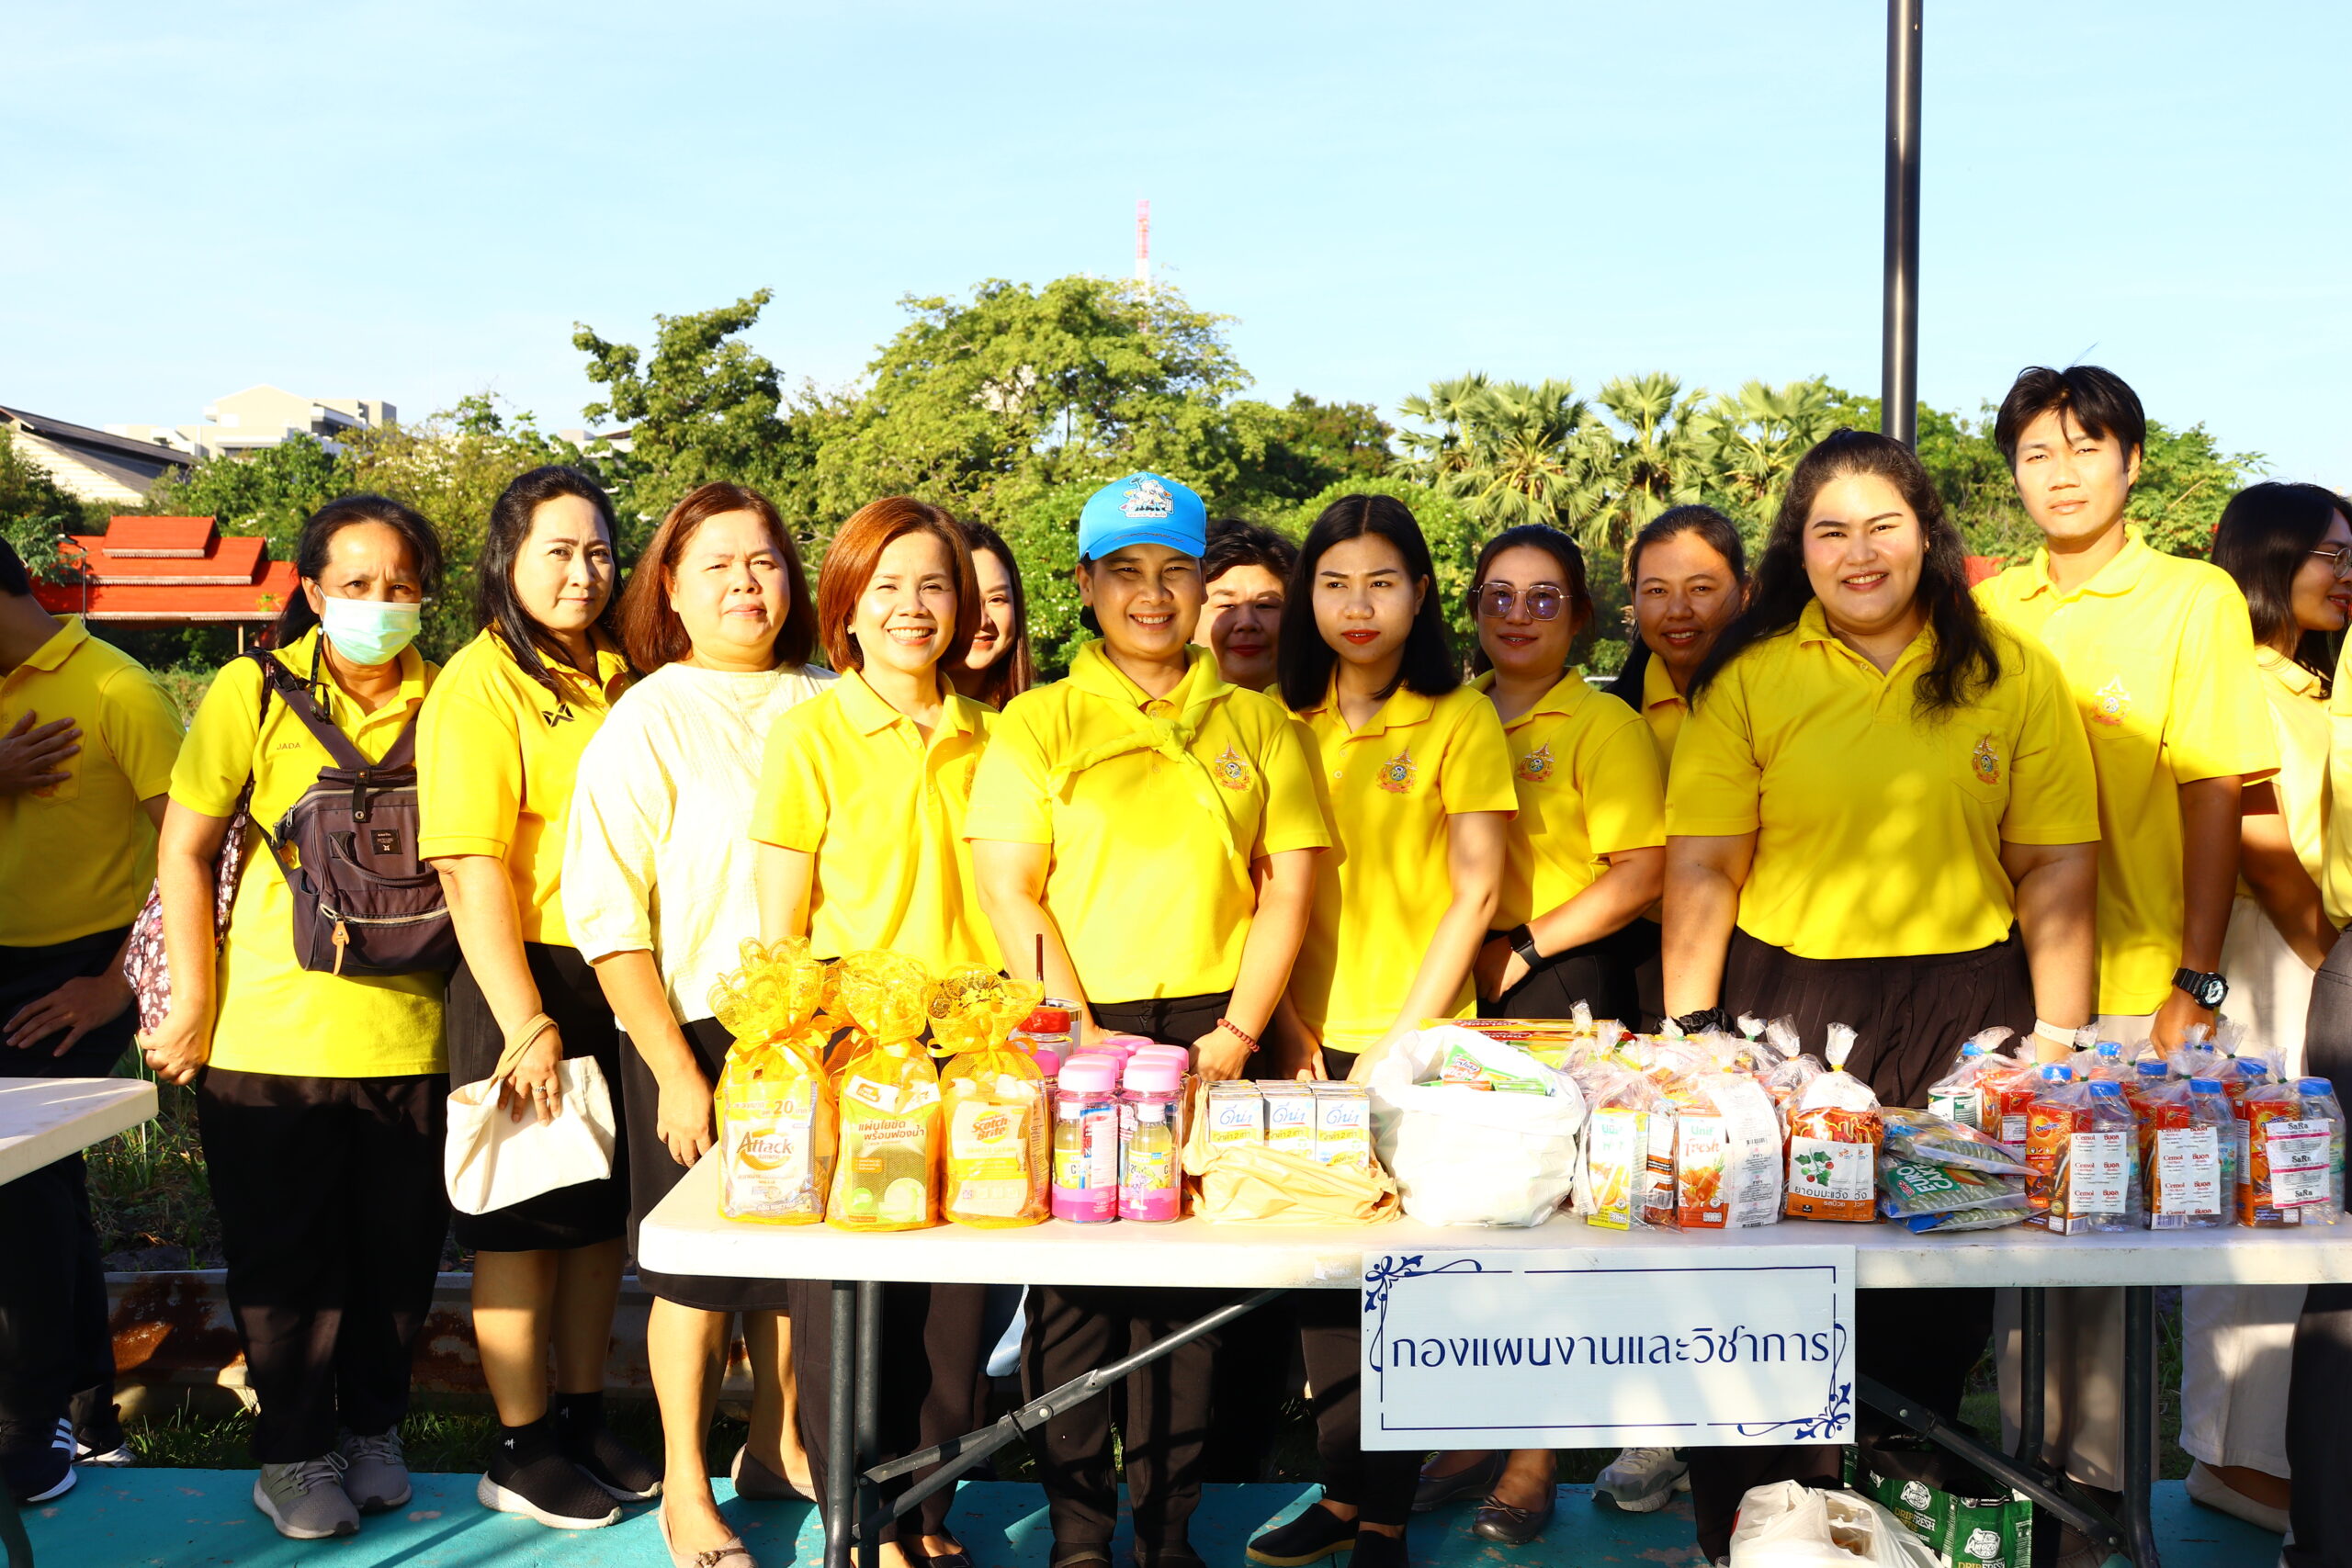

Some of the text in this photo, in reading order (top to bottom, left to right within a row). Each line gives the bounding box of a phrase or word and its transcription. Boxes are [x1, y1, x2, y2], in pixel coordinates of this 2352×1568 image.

[773, 1100, 794, 1115] 20
[1219, 1103, 1252, 1125] ดีน่า
[1272, 1101, 1306, 1123] ดีน่า
[1326, 1103, 1360, 1125] ดีน่า
[970, 1117, 1009, 1133] Scotch
[1691, 1125, 1713, 1135] Unif
[2288, 1122, 2309, 1131] SaRa
[976, 1127, 1006, 1141] Brite
[736, 1131, 793, 1154] Attack
[1684, 1138, 1720, 1156] Fresh
[2291, 1155, 2312, 1164] SaRa
[1896, 1167, 1938, 1192] EURO
[1794, 1186, 1849, 1200] ยาอมมะแว้ง
[2294, 1189, 2312, 1198] SaRa
[1391, 1325, 1830, 1368] กองแผนงานและวิชาการ
[1912, 1514, 1936, 1531] FRESH
